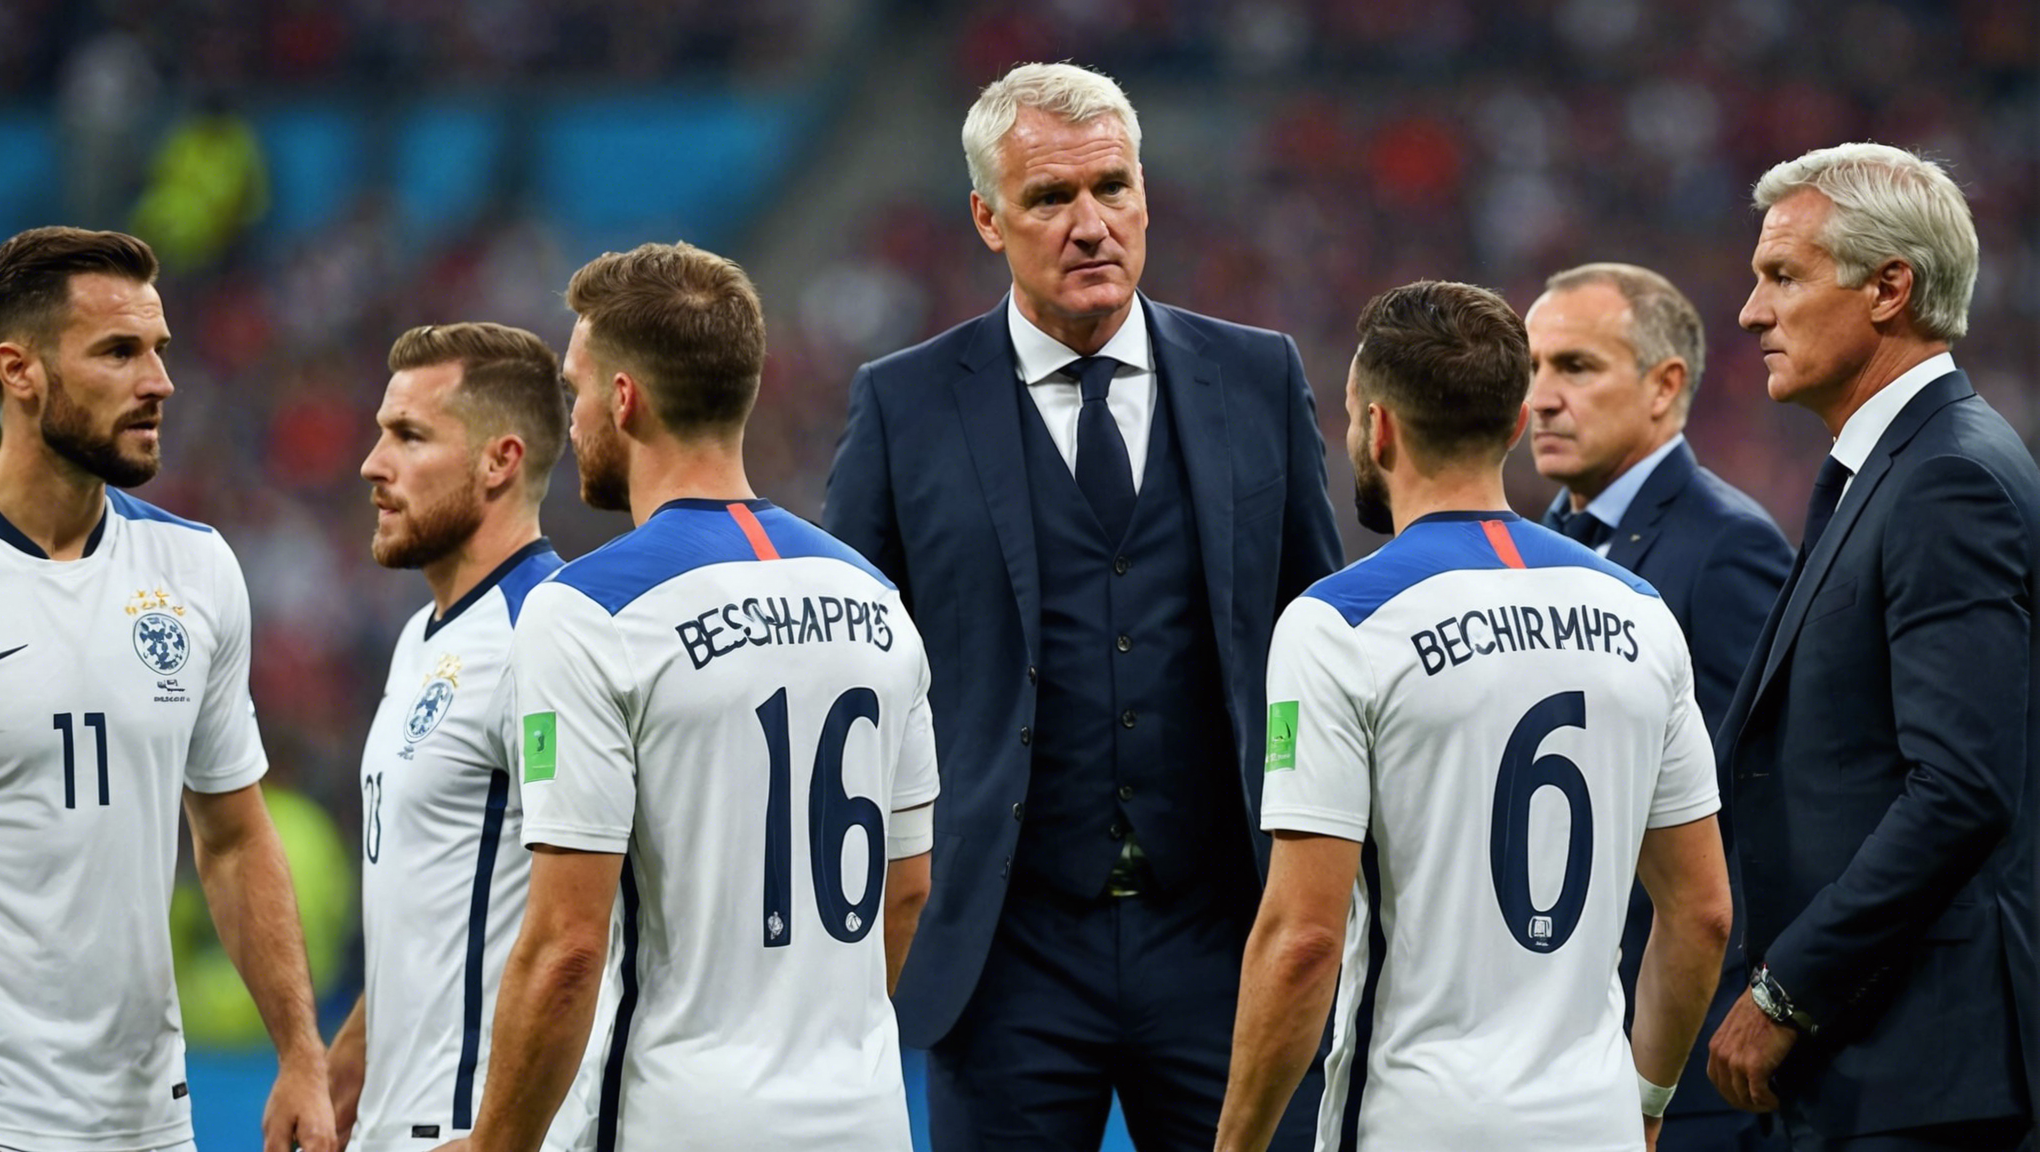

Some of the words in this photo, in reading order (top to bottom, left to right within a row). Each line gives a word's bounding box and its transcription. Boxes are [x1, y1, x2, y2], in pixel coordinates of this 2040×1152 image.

[53, 712, 110, 809] 11
[755, 686, 885, 948] 16
[1490, 691, 1593, 954] 6
